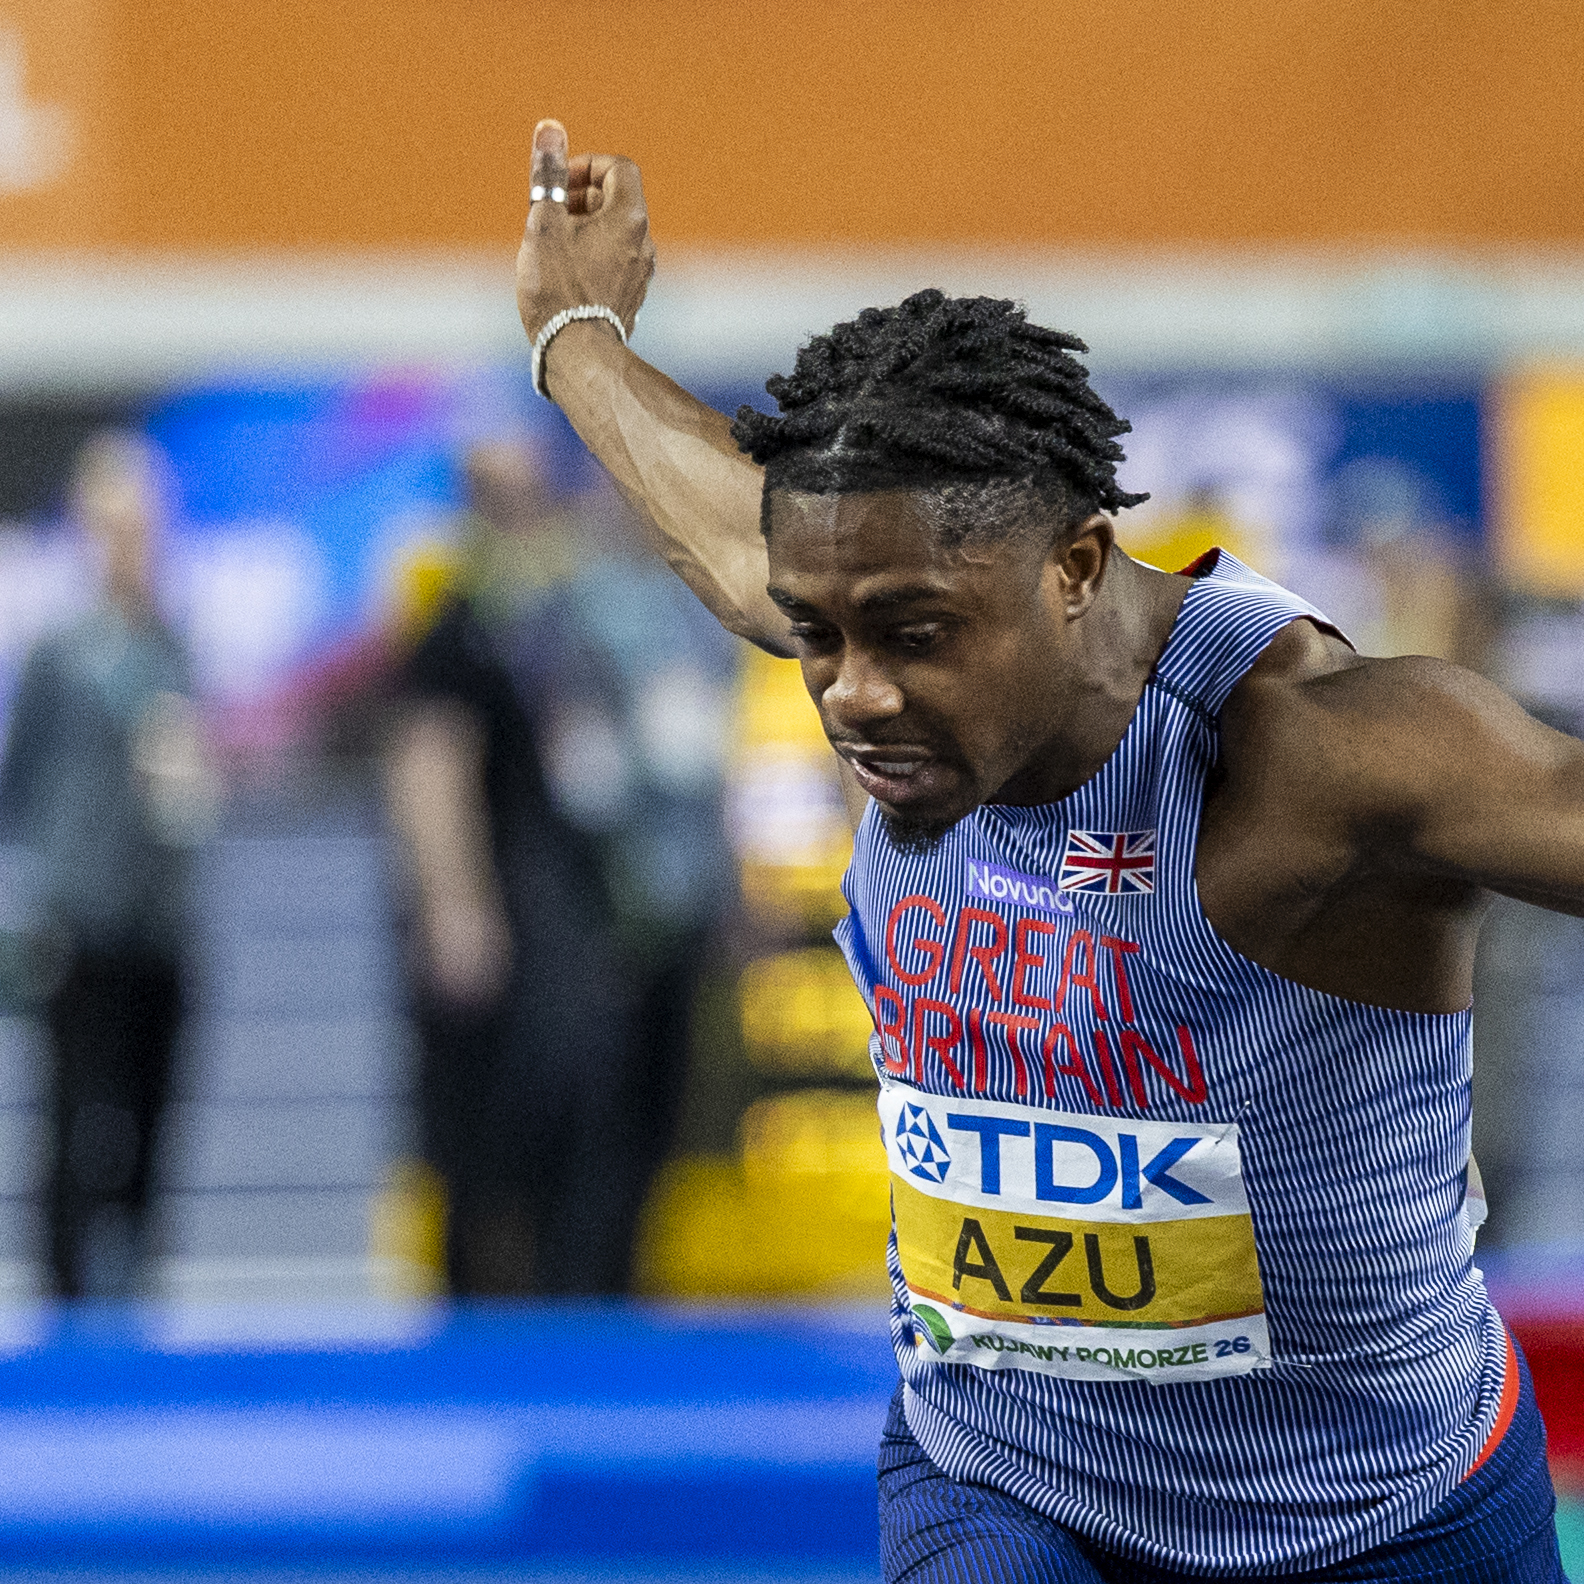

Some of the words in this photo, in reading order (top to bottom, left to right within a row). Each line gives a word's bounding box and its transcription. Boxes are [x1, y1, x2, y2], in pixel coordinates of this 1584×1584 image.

[968, 861, 1074, 913] Novuna
[885, 894, 1141, 1023] GREAT
[873, 983, 1209, 1110] BRITAIN
[946, 1112, 1217, 1211] TDK
[951, 1216, 1156, 1311] AZU
[972, 1334, 1069, 1362] KUJAWY
[1076, 1343, 1209, 1370] POMORZE
[1212, 1335, 1251, 1359] 26
